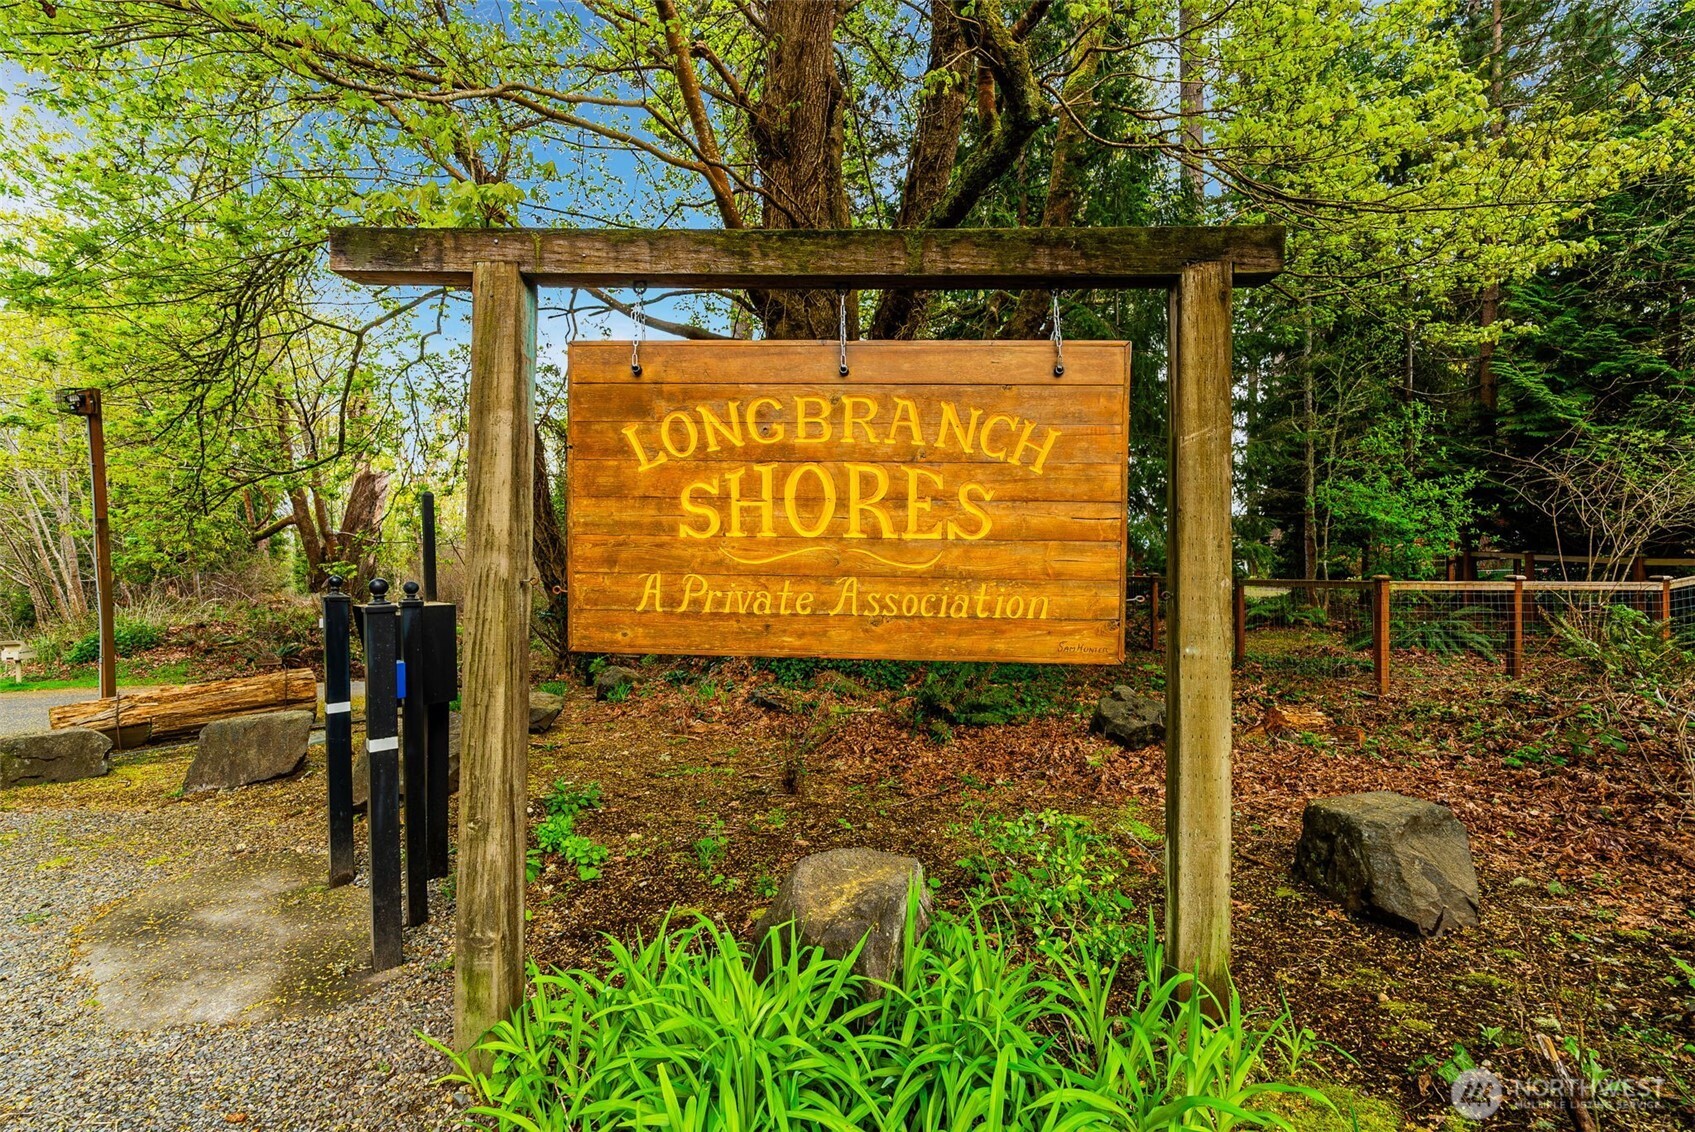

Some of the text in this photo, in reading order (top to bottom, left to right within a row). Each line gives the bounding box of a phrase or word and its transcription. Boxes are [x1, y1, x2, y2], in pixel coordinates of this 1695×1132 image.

[621, 396, 1062, 475] LONGBRANCH
[678, 461, 996, 541] SHORES
[635, 572, 1050, 619] A Private Association
